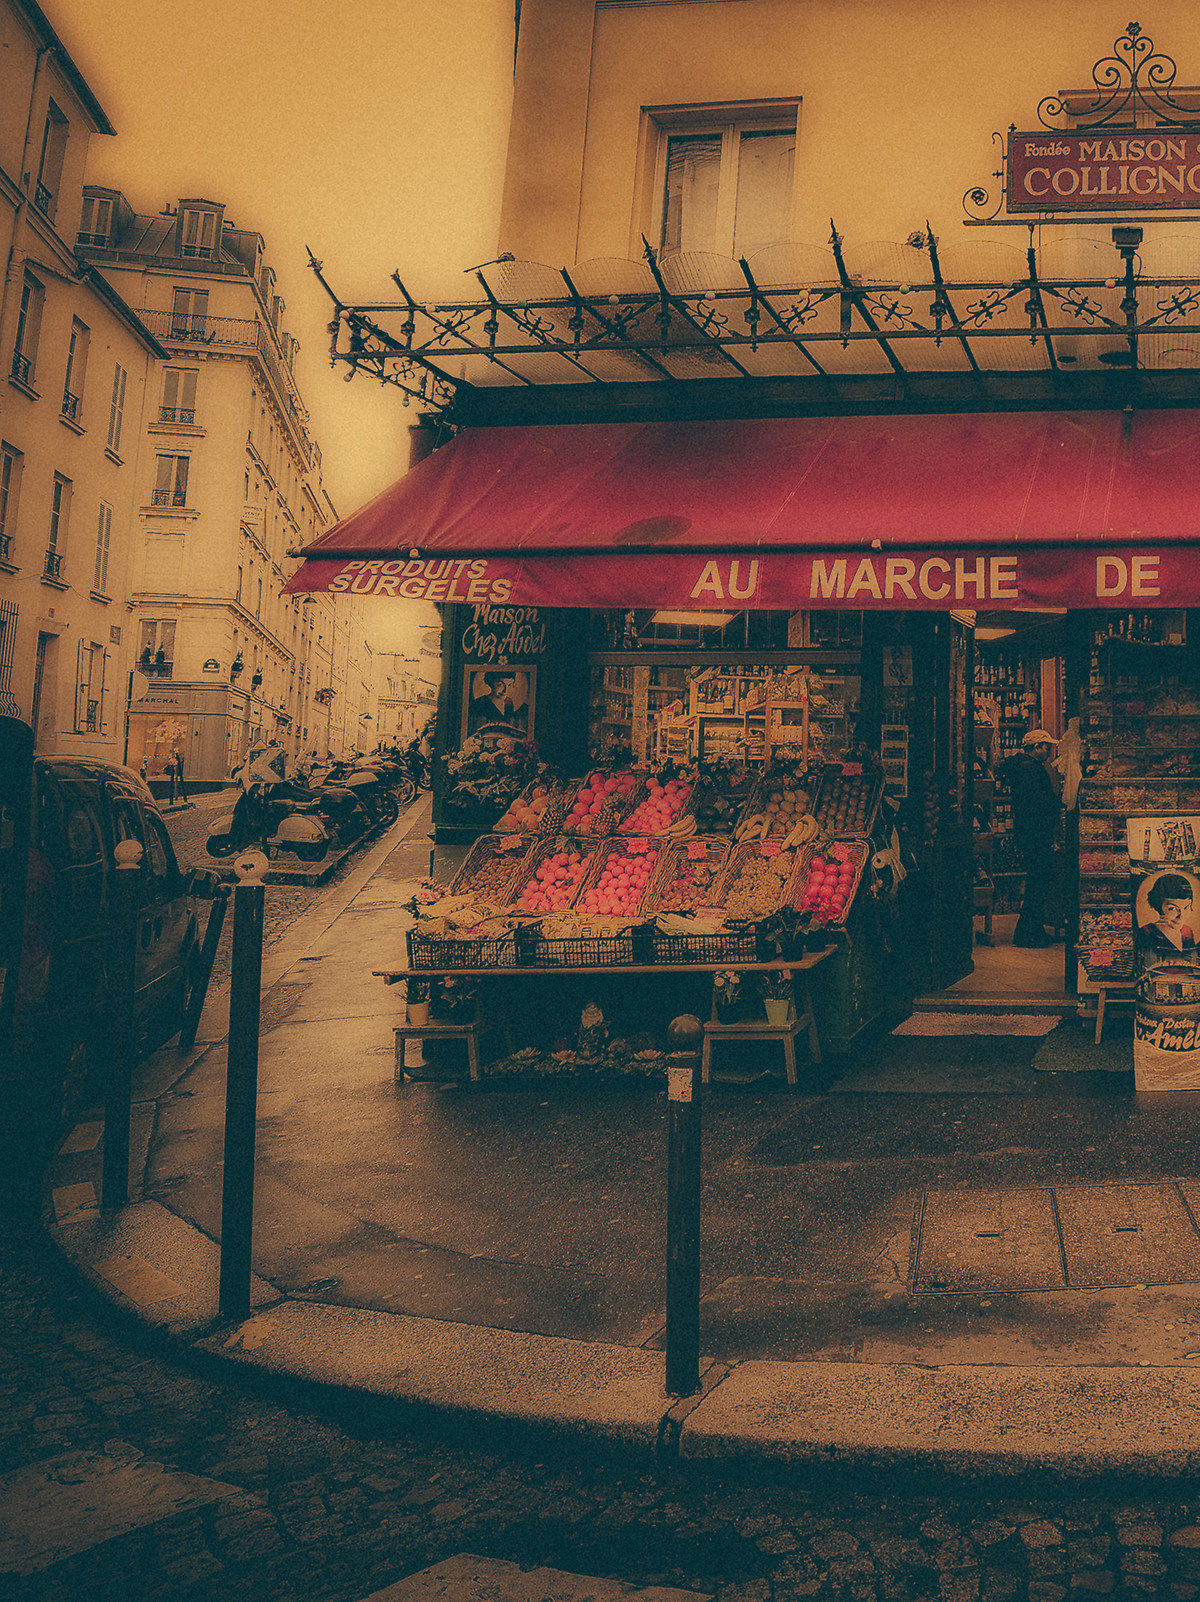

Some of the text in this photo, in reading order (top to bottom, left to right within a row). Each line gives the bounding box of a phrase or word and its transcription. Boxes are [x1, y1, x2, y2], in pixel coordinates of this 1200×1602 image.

[1024, 141, 1071, 157] Fondée
[1078, 139, 1188, 162] MAISON
[341, 559, 488, 580] PRODUITS
[690, 560, 759, 599] AU
[809, 556, 1019, 599] MARCHE
[1096, 555, 1161, 597] DE
[328, 573, 513, 603] SURGELES
[471, 604, 540, 625] Maison
[462, 622, 547, 662] Chez Abdel
